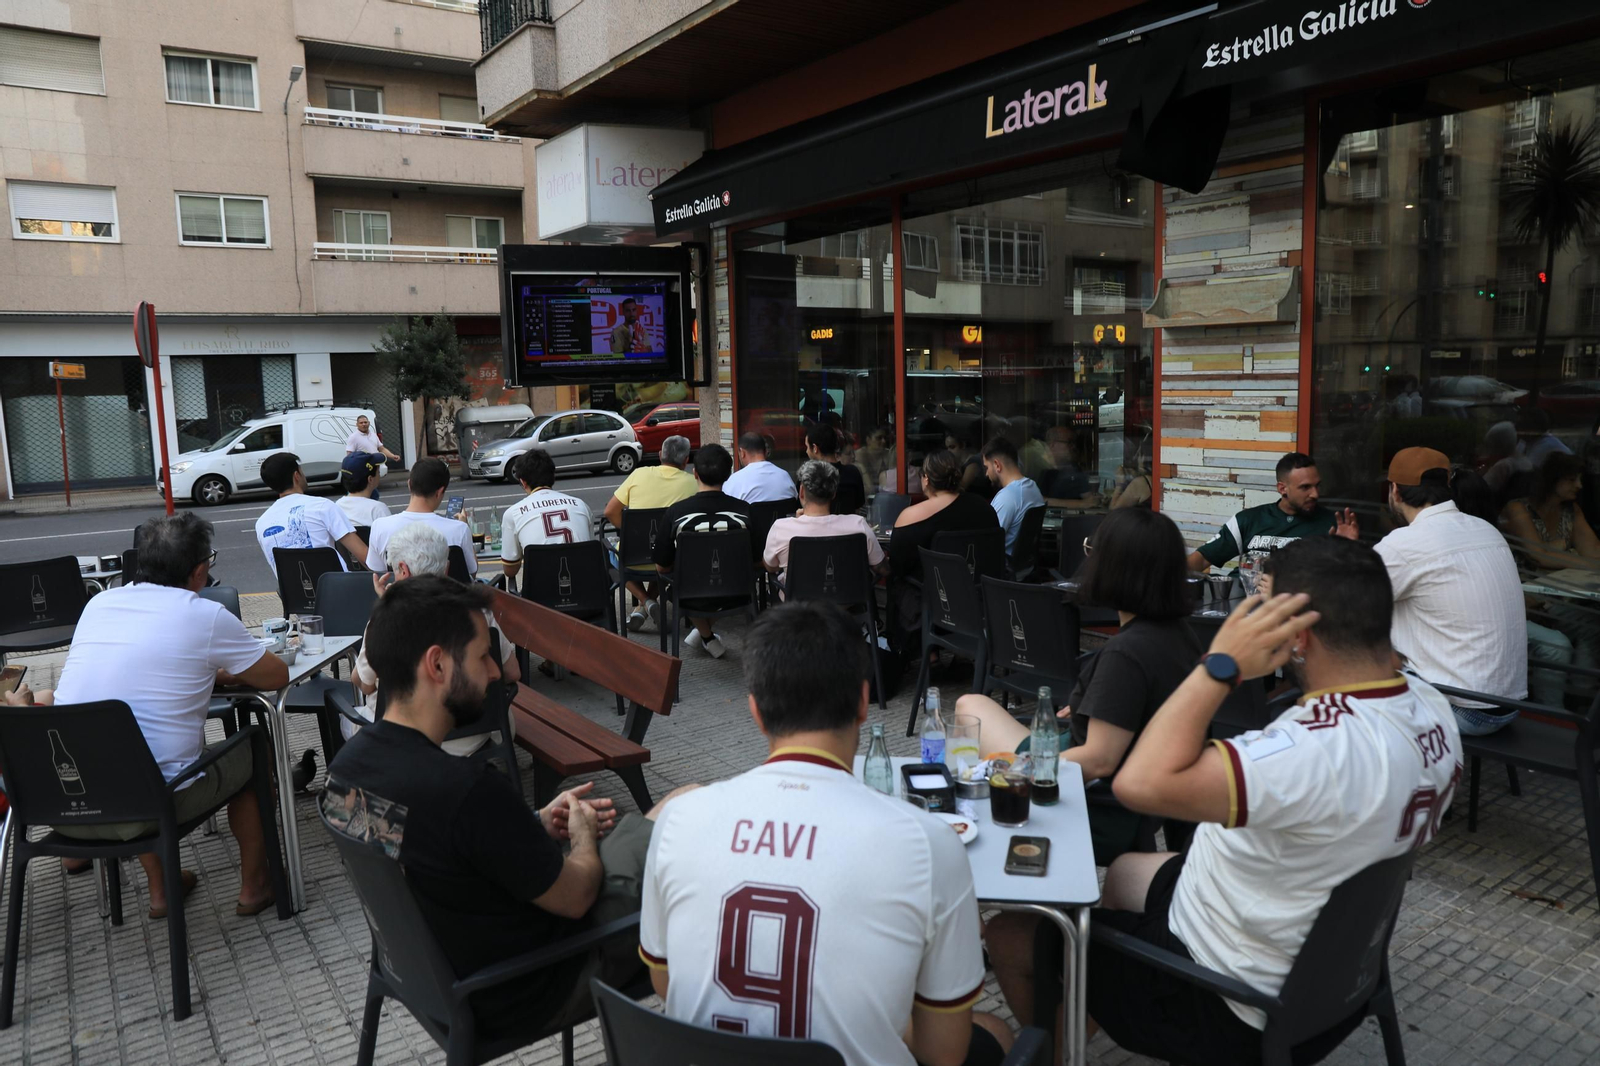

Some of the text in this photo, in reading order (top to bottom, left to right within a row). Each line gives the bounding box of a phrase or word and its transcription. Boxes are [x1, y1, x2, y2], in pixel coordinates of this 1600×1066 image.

[1202, 0, 1399, 69] Estrella Galicia
[985, 63, 1107, 139] Lateral
[665, 194, 721, 224] Estrella Galicia
[810, 328, 833, 339] GADIS
[479, 369, 497, 378] 365
[531, 498, 579, 510] LLORENTE
[540, 508, 574, 543] 5
[730, 819, 817, 860] GAVI
[712, 881, 820, 1041] 9
